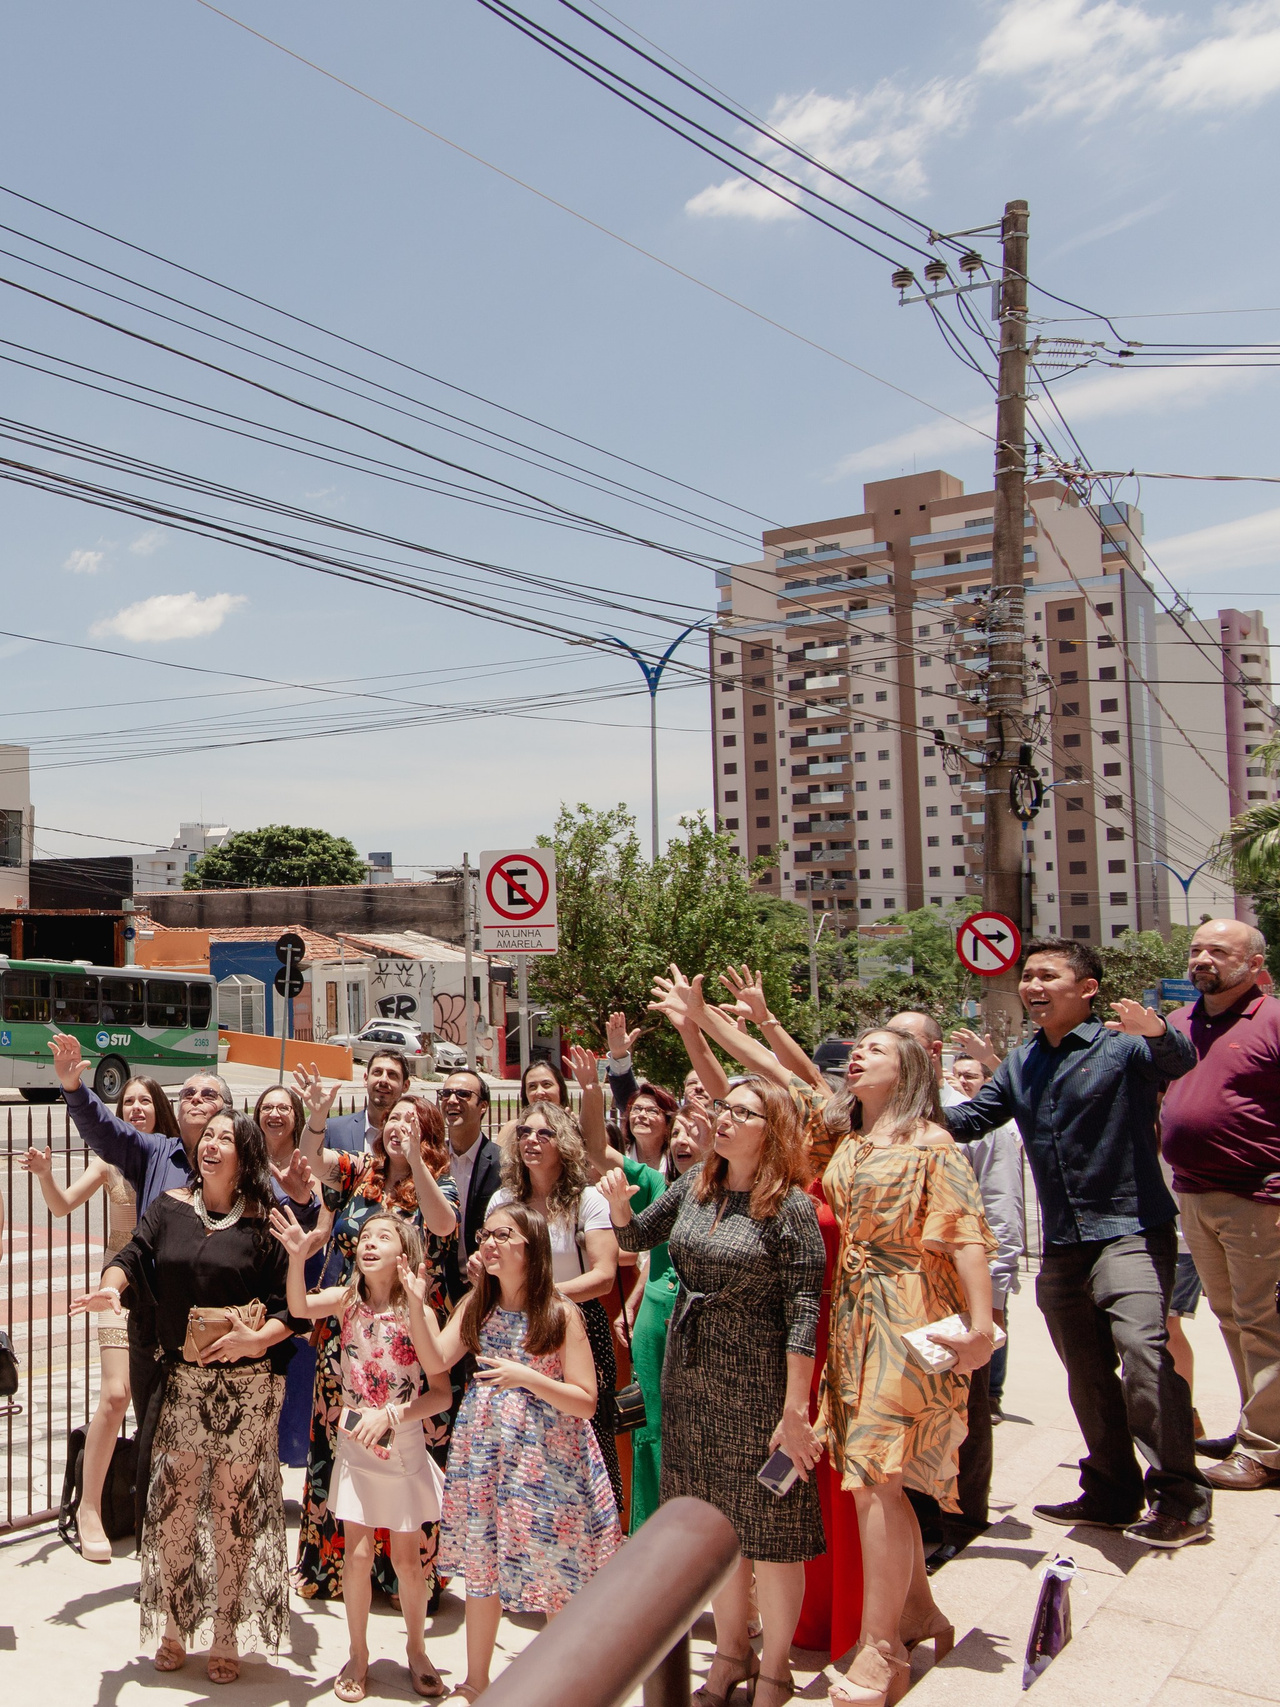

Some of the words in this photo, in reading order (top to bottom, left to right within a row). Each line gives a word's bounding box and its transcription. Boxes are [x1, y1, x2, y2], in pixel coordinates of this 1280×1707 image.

[497, 929, 511, 937] NA
[512, 929, 541, 937] LINHA
[496, 940, 543, 948] AMARELA
[1165, 983, 1194, 991] Pernambuco
[110, 1034, 131, 1046] STU
[194, 1038, 209, 1047] 2363
